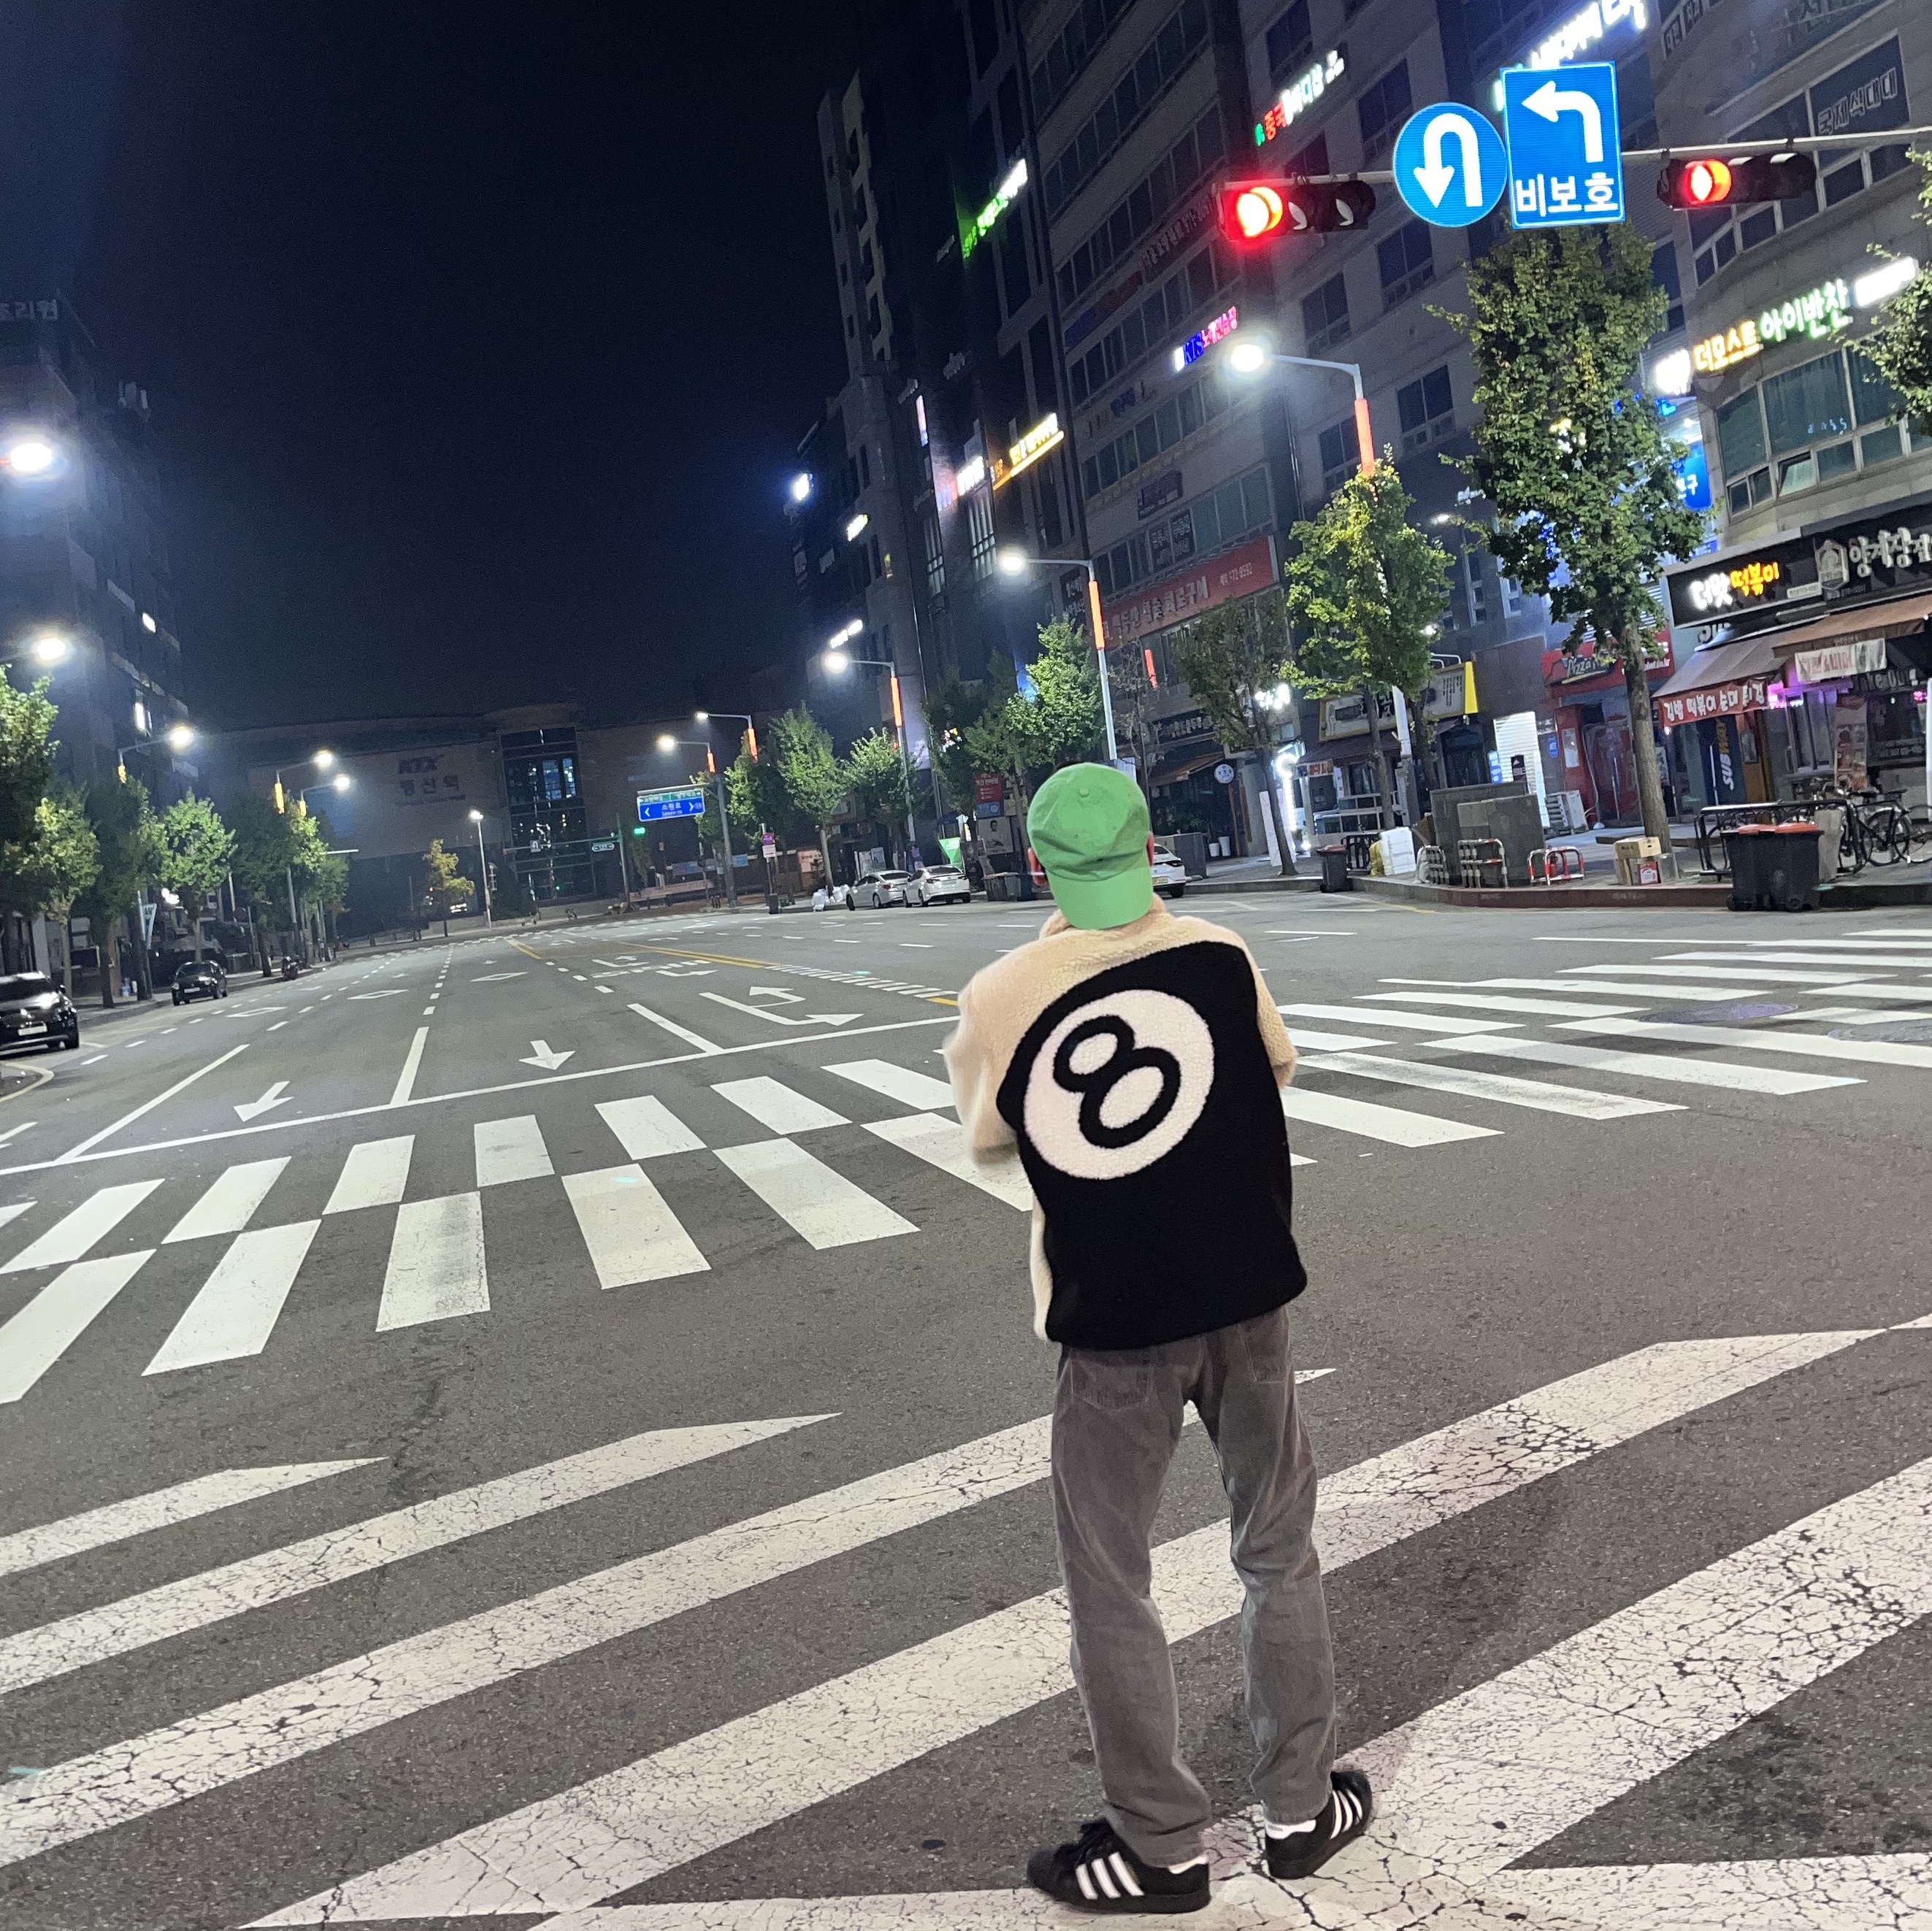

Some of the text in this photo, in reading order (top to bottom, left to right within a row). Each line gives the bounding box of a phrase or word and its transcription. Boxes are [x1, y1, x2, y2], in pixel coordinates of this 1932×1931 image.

[1516, 172, 1618, 217] 비보호
[1664, 699, 1684, 722] 김밥
[1686, 694, 1716, 717] 떡볶이
[1053, 1015, 1181, 1149] 8
